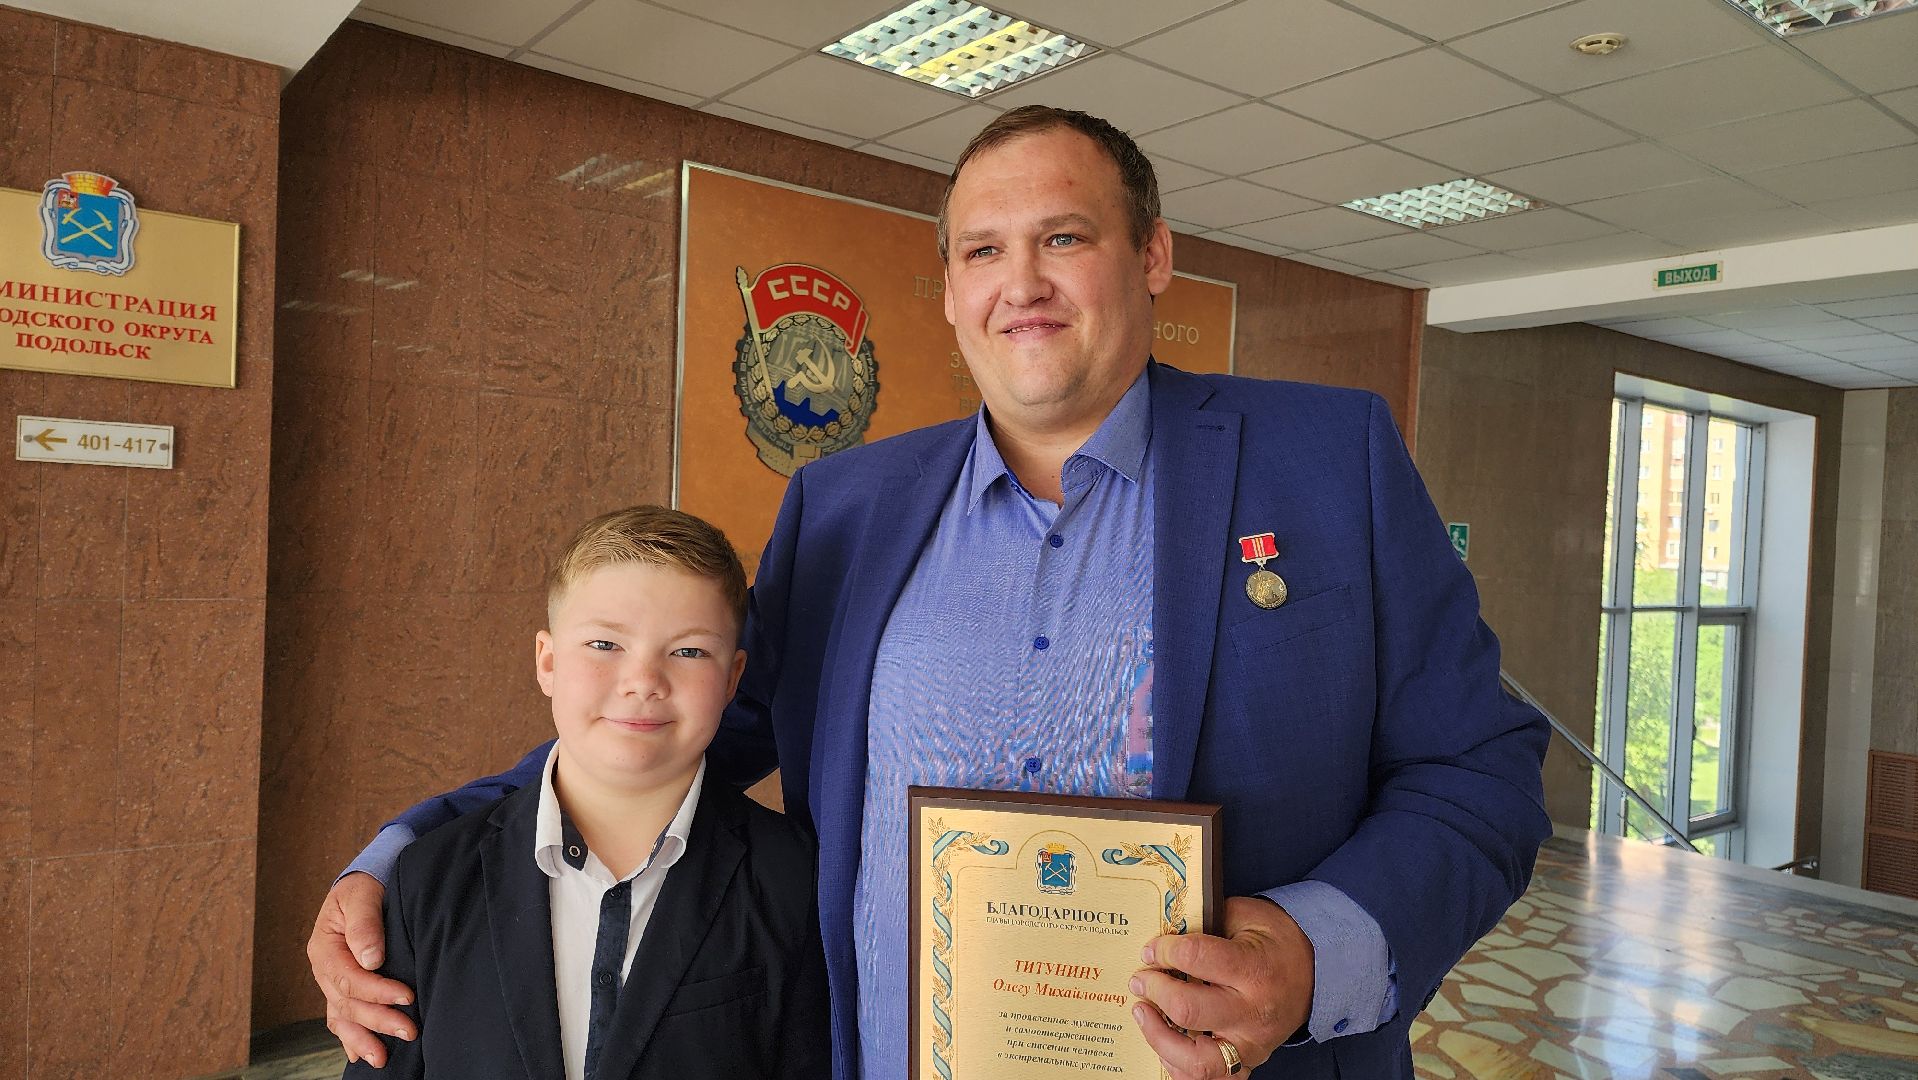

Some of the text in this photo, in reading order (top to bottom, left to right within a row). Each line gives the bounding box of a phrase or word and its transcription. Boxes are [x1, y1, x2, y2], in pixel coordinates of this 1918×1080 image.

[1665, 267, 1711, 285] ВЫХОД
[767, 276, 850, 310] СССР
[0, 308, 214, 345] ОДСКОГО ОКРУГА
[16, 332, 152, 361] ПОДОЛЬСК
[77, 432, 158, 454] 401-417
[986, 901, 1129, 926] БЛАГОДАРНОСТЬ
[1090, 927, 1129, 935] ПОДОЛЬСК
[1014, 960, 1104, 981] ТИТУНИНУ
[993, 977, 1129, 1007] Олегу Михайловичу
[1010, 1012, 1070, 1025] проявленное
[1071, 1019, 1123, 1032] мужество
[1014, 1026, 1115, 1044] самоотверженность
[1007, 1039, 1114, 1058] при спасении человека
[1004, 1052, 1079, 1068] экстремальных
[1080, 1062, 1124, 1074] условиях
